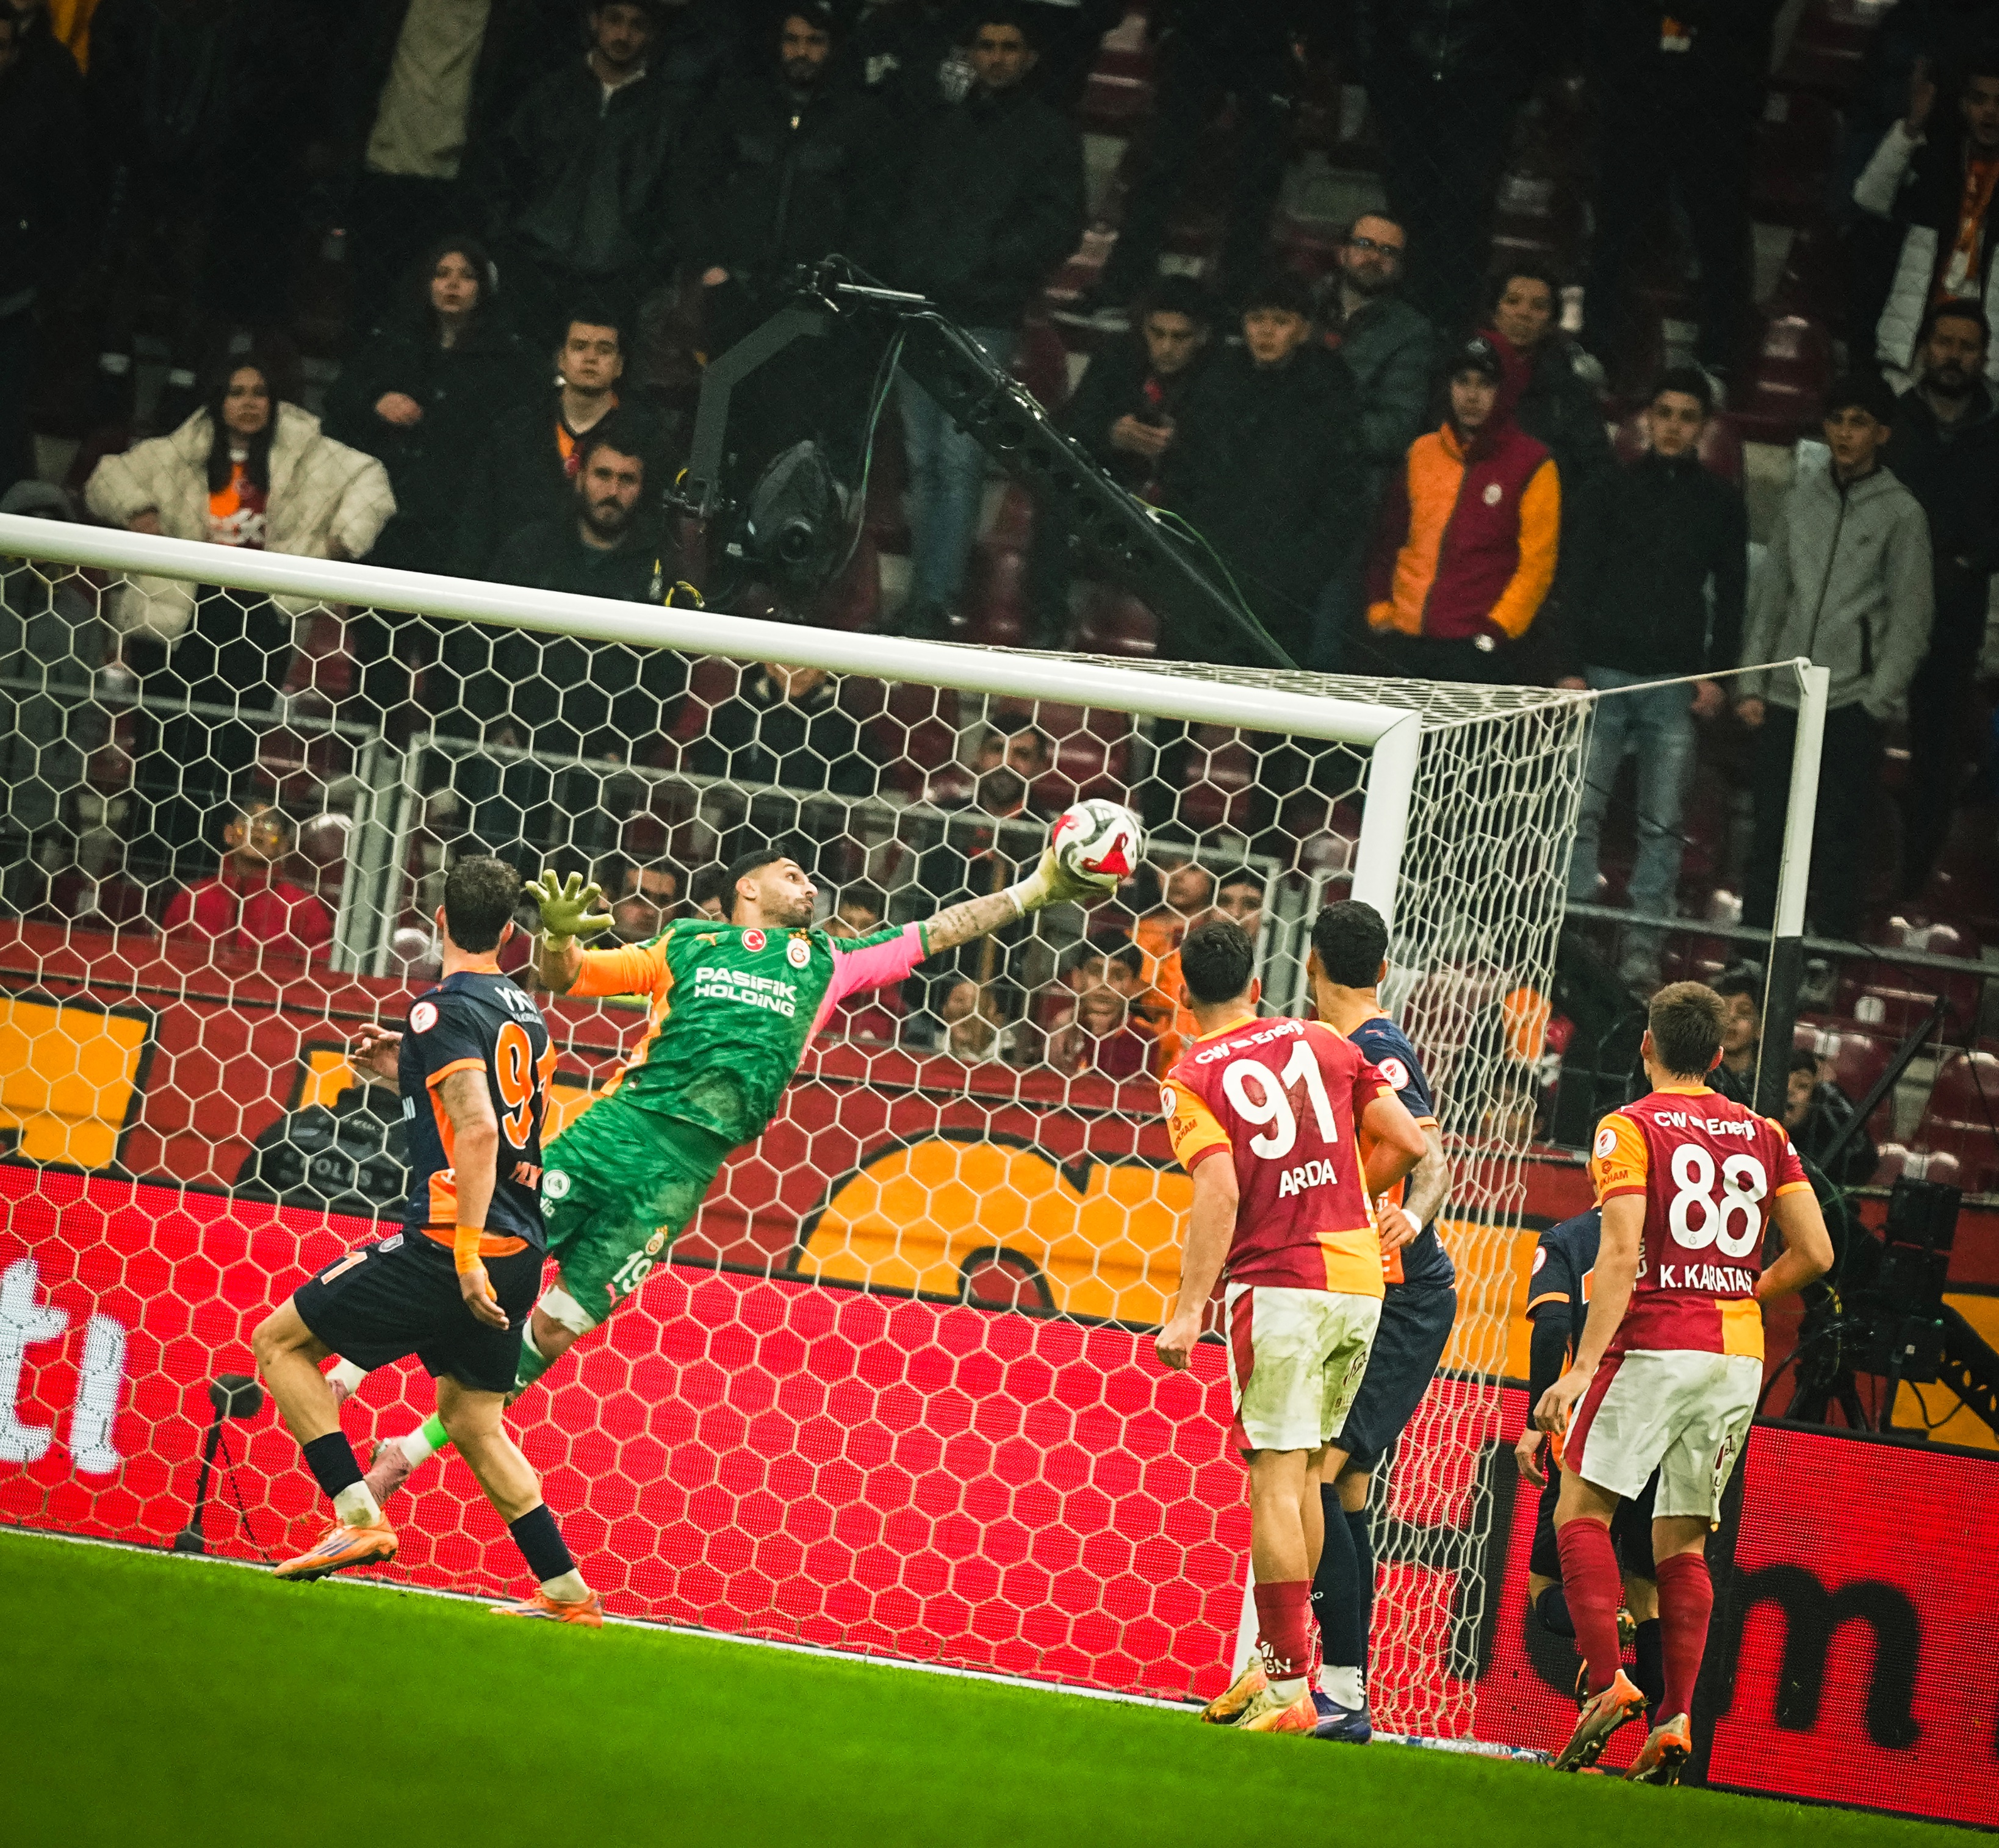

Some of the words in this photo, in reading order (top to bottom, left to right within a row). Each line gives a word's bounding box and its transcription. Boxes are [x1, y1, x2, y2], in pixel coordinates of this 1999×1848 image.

[1195, 1043, 1230, 1064] CW
[1222, 1040, 1338, 1160] 91
[1654, 1112, 1687, 1127] CW
[1706, 1118, 1756, 1141] Enerji
[1278, 1159, 1338, 1198] ARDA
[1669, 1143, 1768, 1257] 88
[613, 1250, 653, 1293] 19
